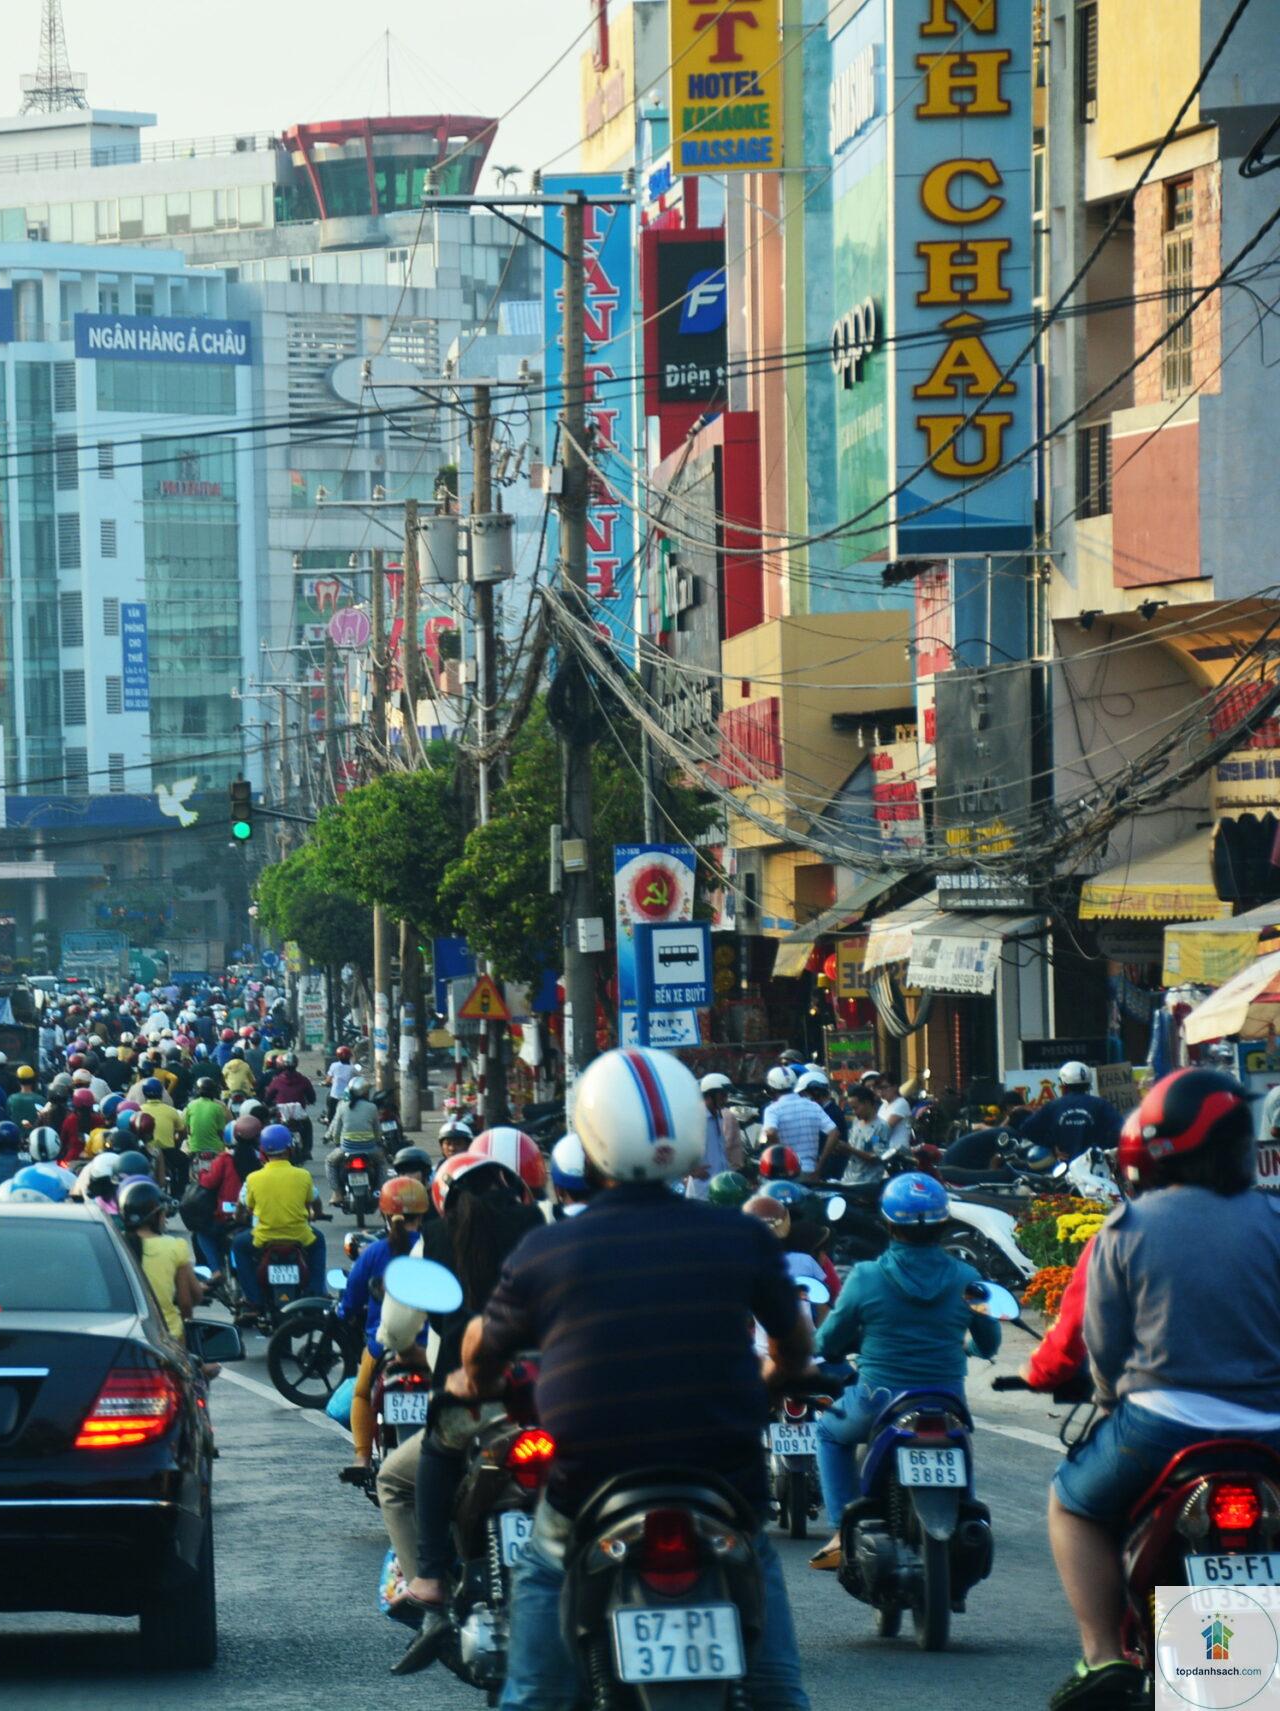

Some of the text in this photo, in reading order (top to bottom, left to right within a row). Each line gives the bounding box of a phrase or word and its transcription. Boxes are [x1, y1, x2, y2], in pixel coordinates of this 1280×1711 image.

[688, 70, 765, 100] HOTEL
[683, 103, 771, 132] KARAOKE
[681, 136, 774, 166] MASSAGE
[913, 157, 1017, 480] CHÂU
[88, 322, 246, 356] NGÂN HÀNG Á CHÂU
[392, 1408, 427, 1422] 3046
[912, 1468, 957, 1484] 3885
[1203, 1556, 1275, 1582] 65-F1
[633, 1610, 718, 1642] 67-P1
[637, 1643, 726, 1677] 3706
